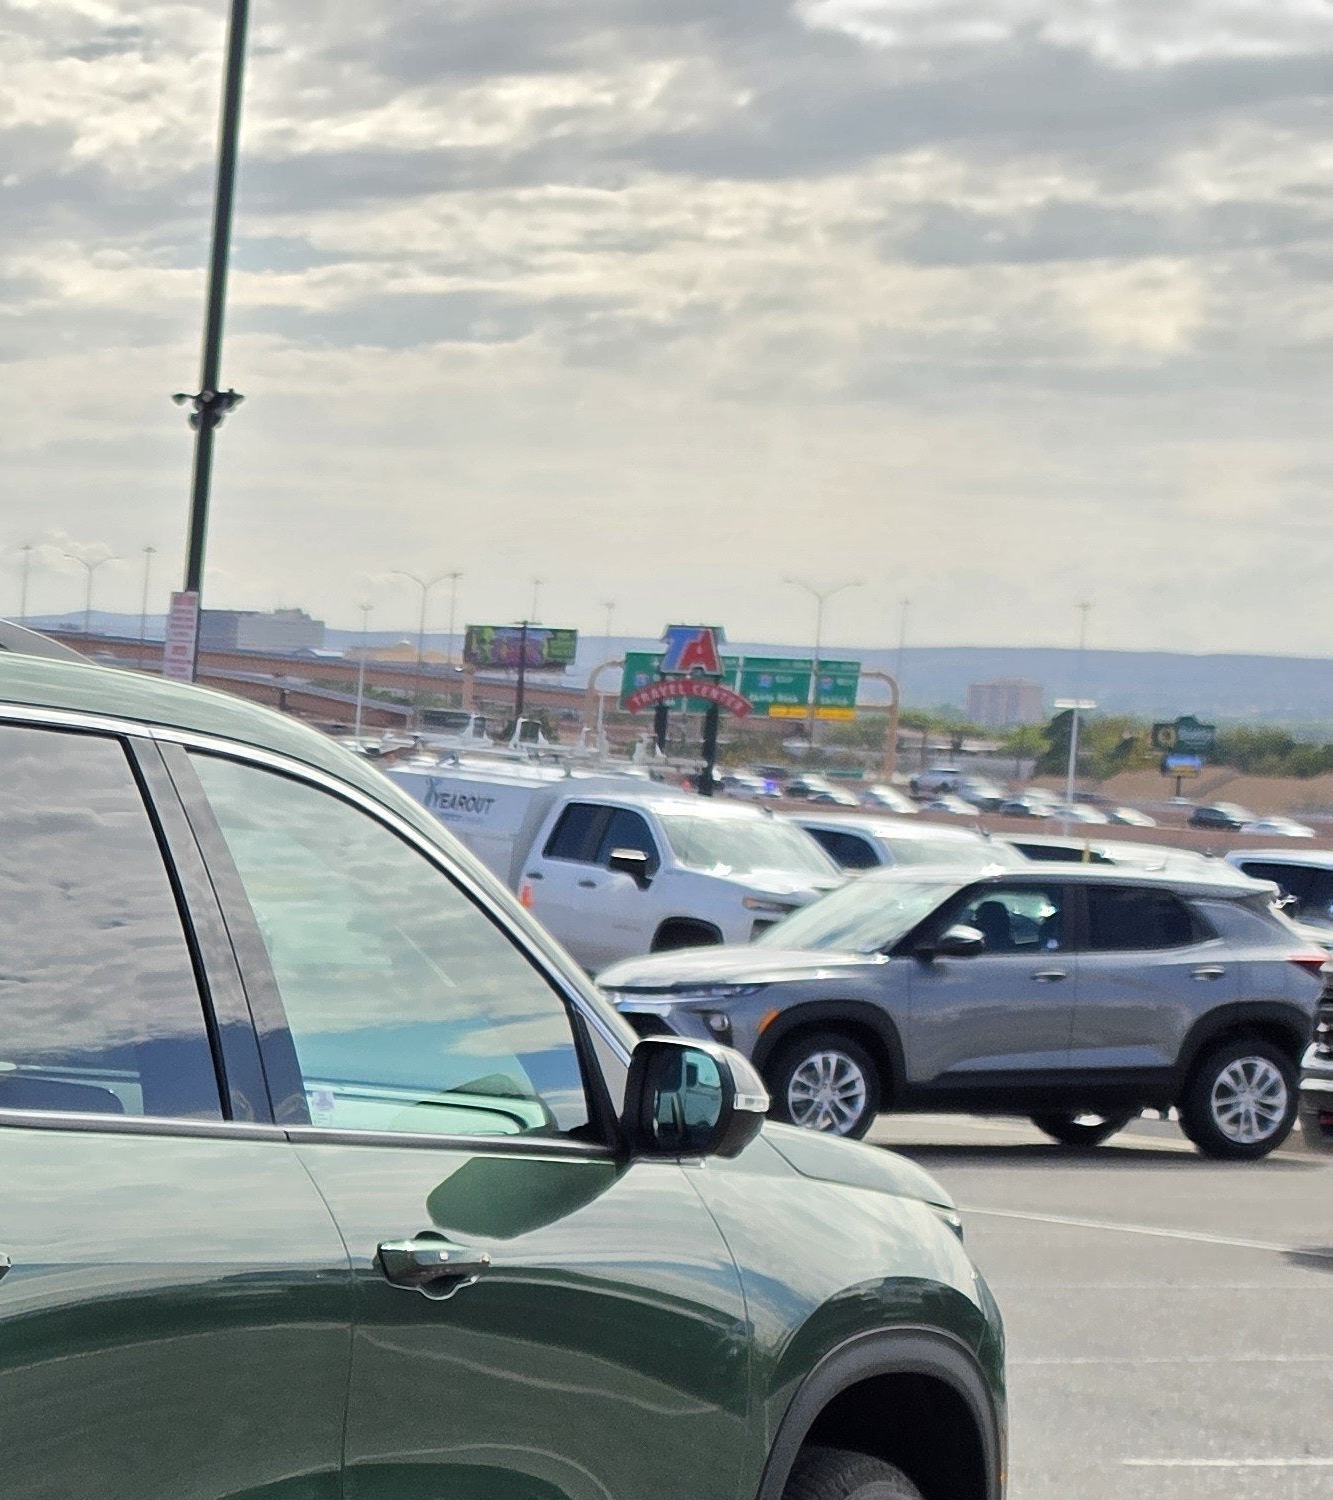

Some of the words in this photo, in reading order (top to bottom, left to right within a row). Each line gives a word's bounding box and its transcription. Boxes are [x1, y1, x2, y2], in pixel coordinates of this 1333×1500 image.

[661, 628, 722, 674] TA
[635, 682, 684, 706] TRAVEL
[691, 682, 745, 711] CENTER
